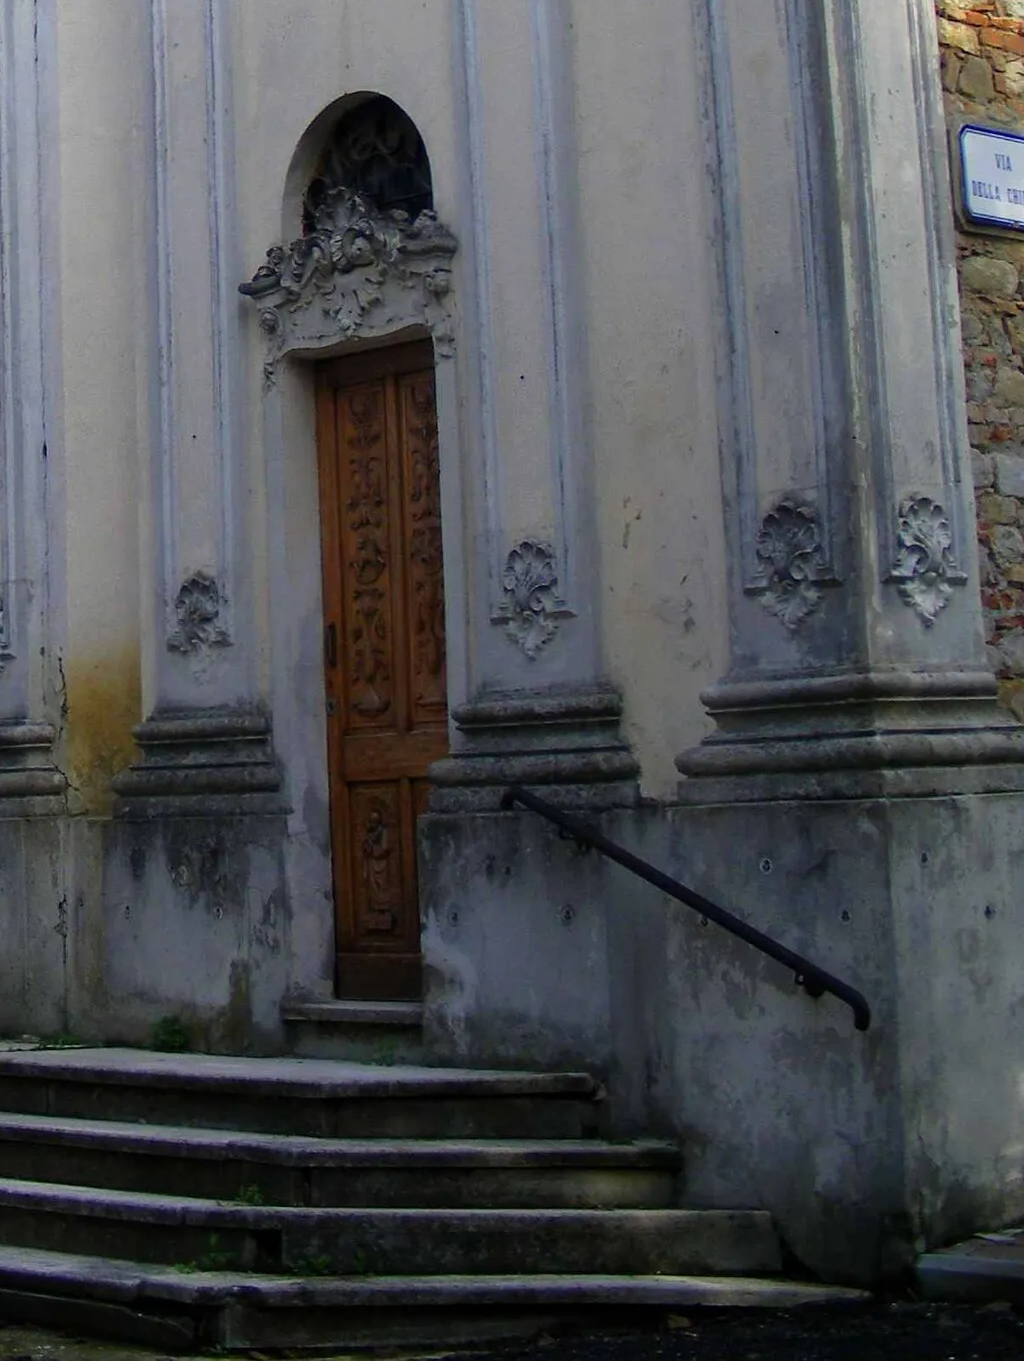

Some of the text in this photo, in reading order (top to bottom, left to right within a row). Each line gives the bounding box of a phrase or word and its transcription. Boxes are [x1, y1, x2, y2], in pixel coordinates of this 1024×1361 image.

[994, 153, 1012, 171] VIA
[971, 180, 1024, 205] DELLA CHI
